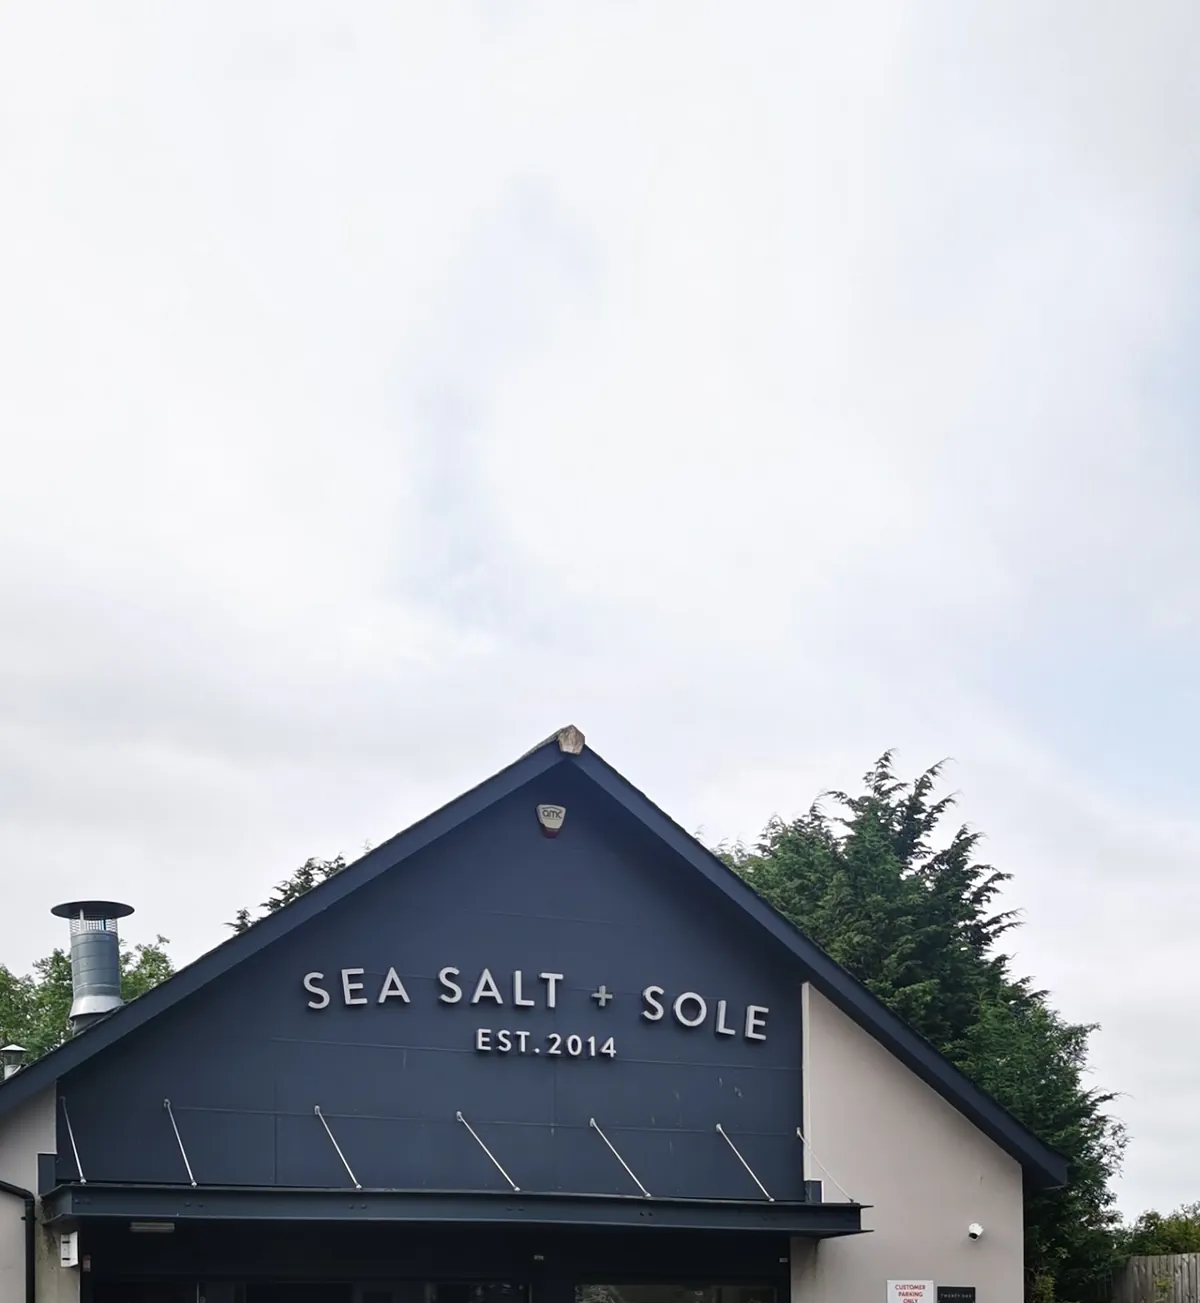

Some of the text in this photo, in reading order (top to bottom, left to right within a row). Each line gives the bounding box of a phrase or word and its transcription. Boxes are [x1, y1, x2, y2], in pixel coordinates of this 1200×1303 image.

[303, 966, 769, 1041] SEA SALT + SOLE
